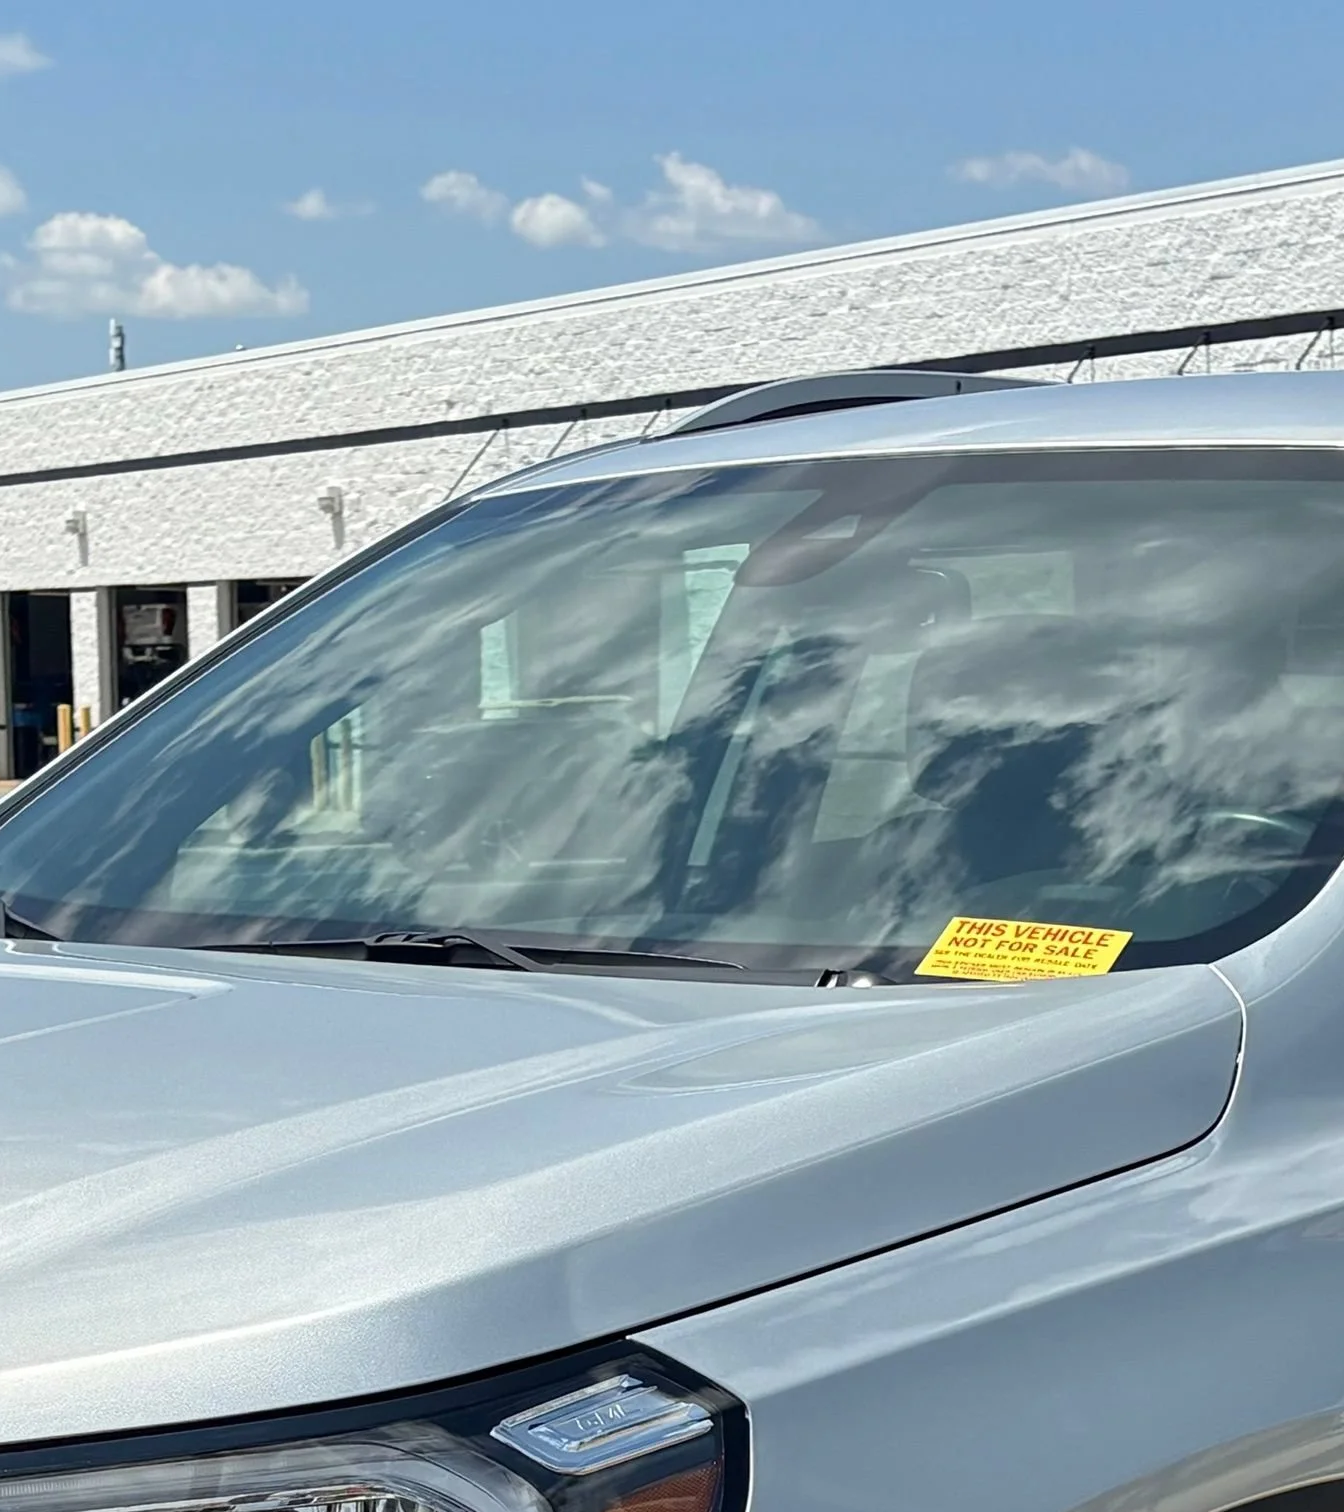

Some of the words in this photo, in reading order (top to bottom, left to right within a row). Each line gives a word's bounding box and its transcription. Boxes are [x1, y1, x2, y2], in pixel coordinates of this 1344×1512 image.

[955, 920, 1008, 937] THIS
[1014, 925, 1115, 947] VEHICLE
[948, 937, 992, 949] NOT
[995, 940, 1038, 954] FOR
[1043, 946, 1098, 960] SALE
